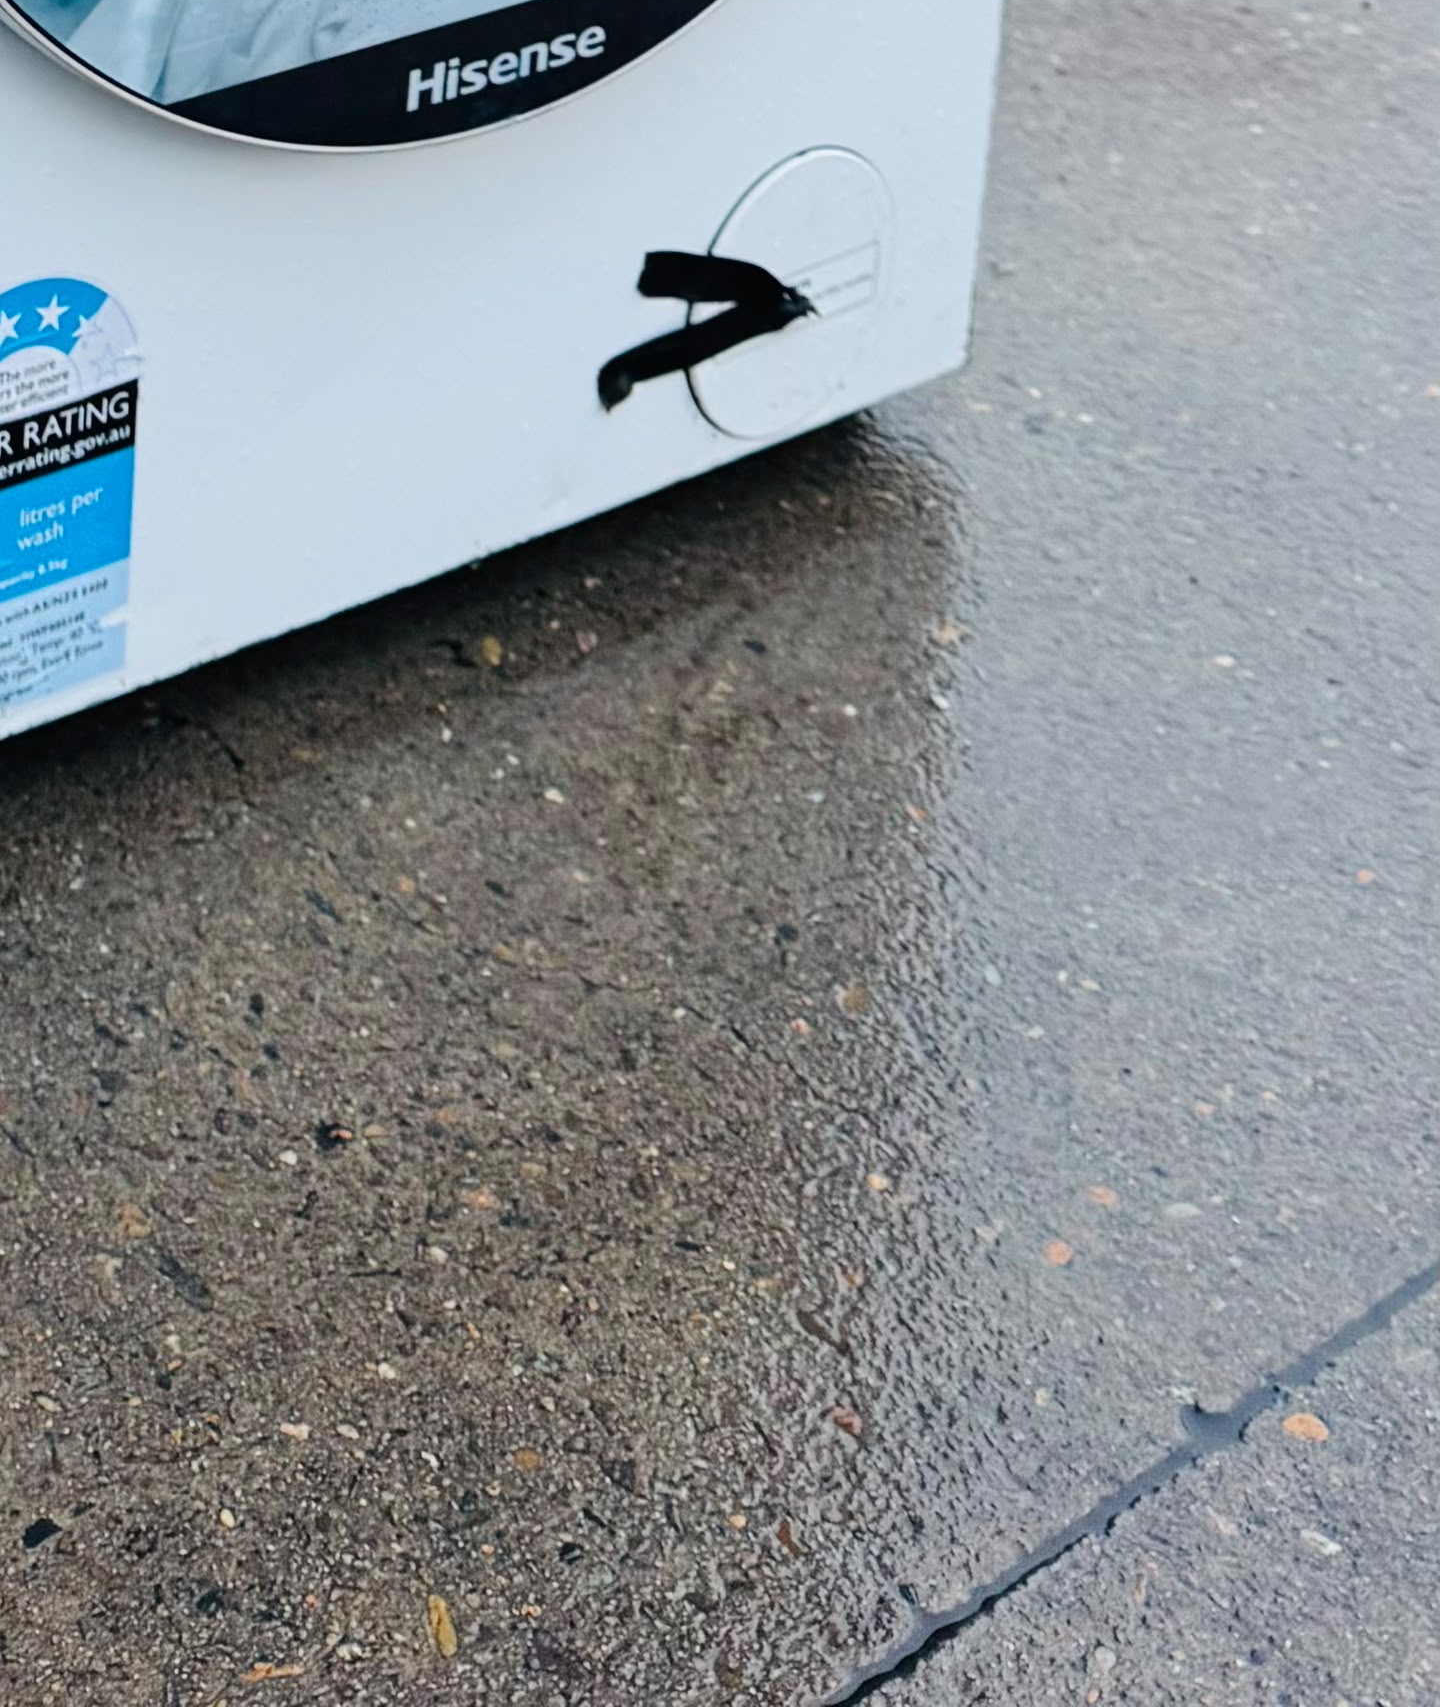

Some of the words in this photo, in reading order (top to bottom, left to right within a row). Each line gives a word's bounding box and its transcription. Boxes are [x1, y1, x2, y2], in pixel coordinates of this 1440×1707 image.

[406, 25, 607, 112] Hisense
[14, 379, 36, 394] the
[38, 370, 69, 389] more
[23, 360, 57, 376] more
[22, 391, 130, 450] RATING
[19, 500, 65, 528] litres
[71, 487, 103, 515] per
[17, 521, 64, 550] wash
